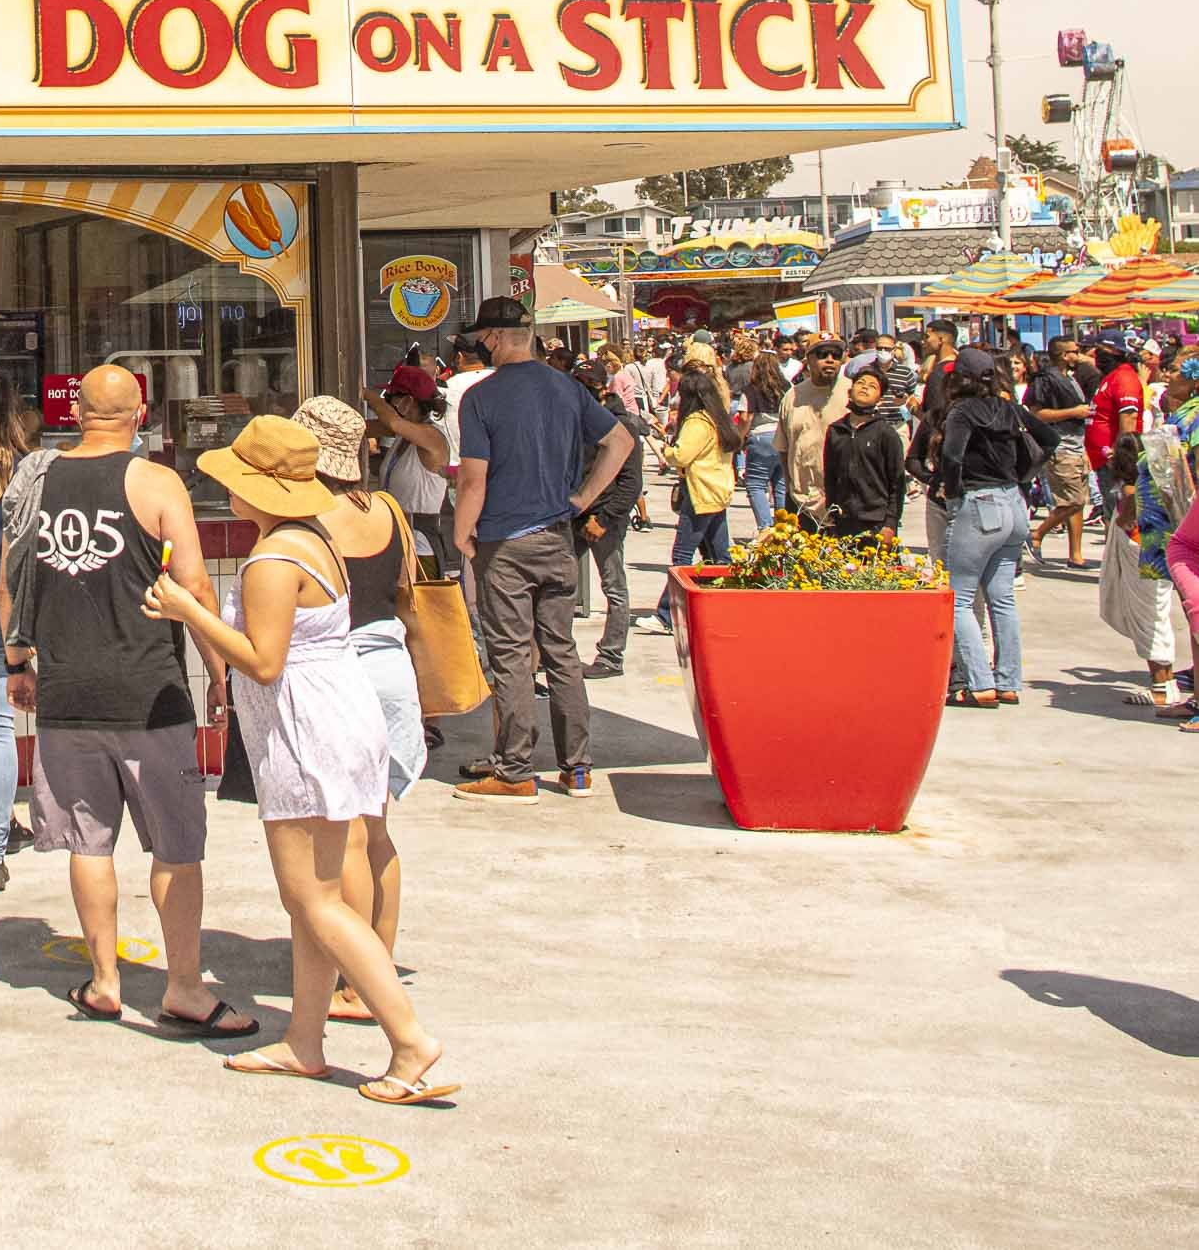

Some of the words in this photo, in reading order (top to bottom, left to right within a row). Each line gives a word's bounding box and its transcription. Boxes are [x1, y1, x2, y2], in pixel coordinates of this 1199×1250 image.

[352, 10, 463, 73] ON
[480, 12, 535, 72] A
[938, 203, 1029, 226] CHURO
[671, 214, 803, 240] TSUNAMI
[385, 263, 411, 279] Rice
[414, 261, 456, 278] Bowls
[510, 279, 531, 296] ER
[47, 389, 67, 399] HOT
[69, 389, 81, 399] DO
[37, 508, 125, 559] 305
